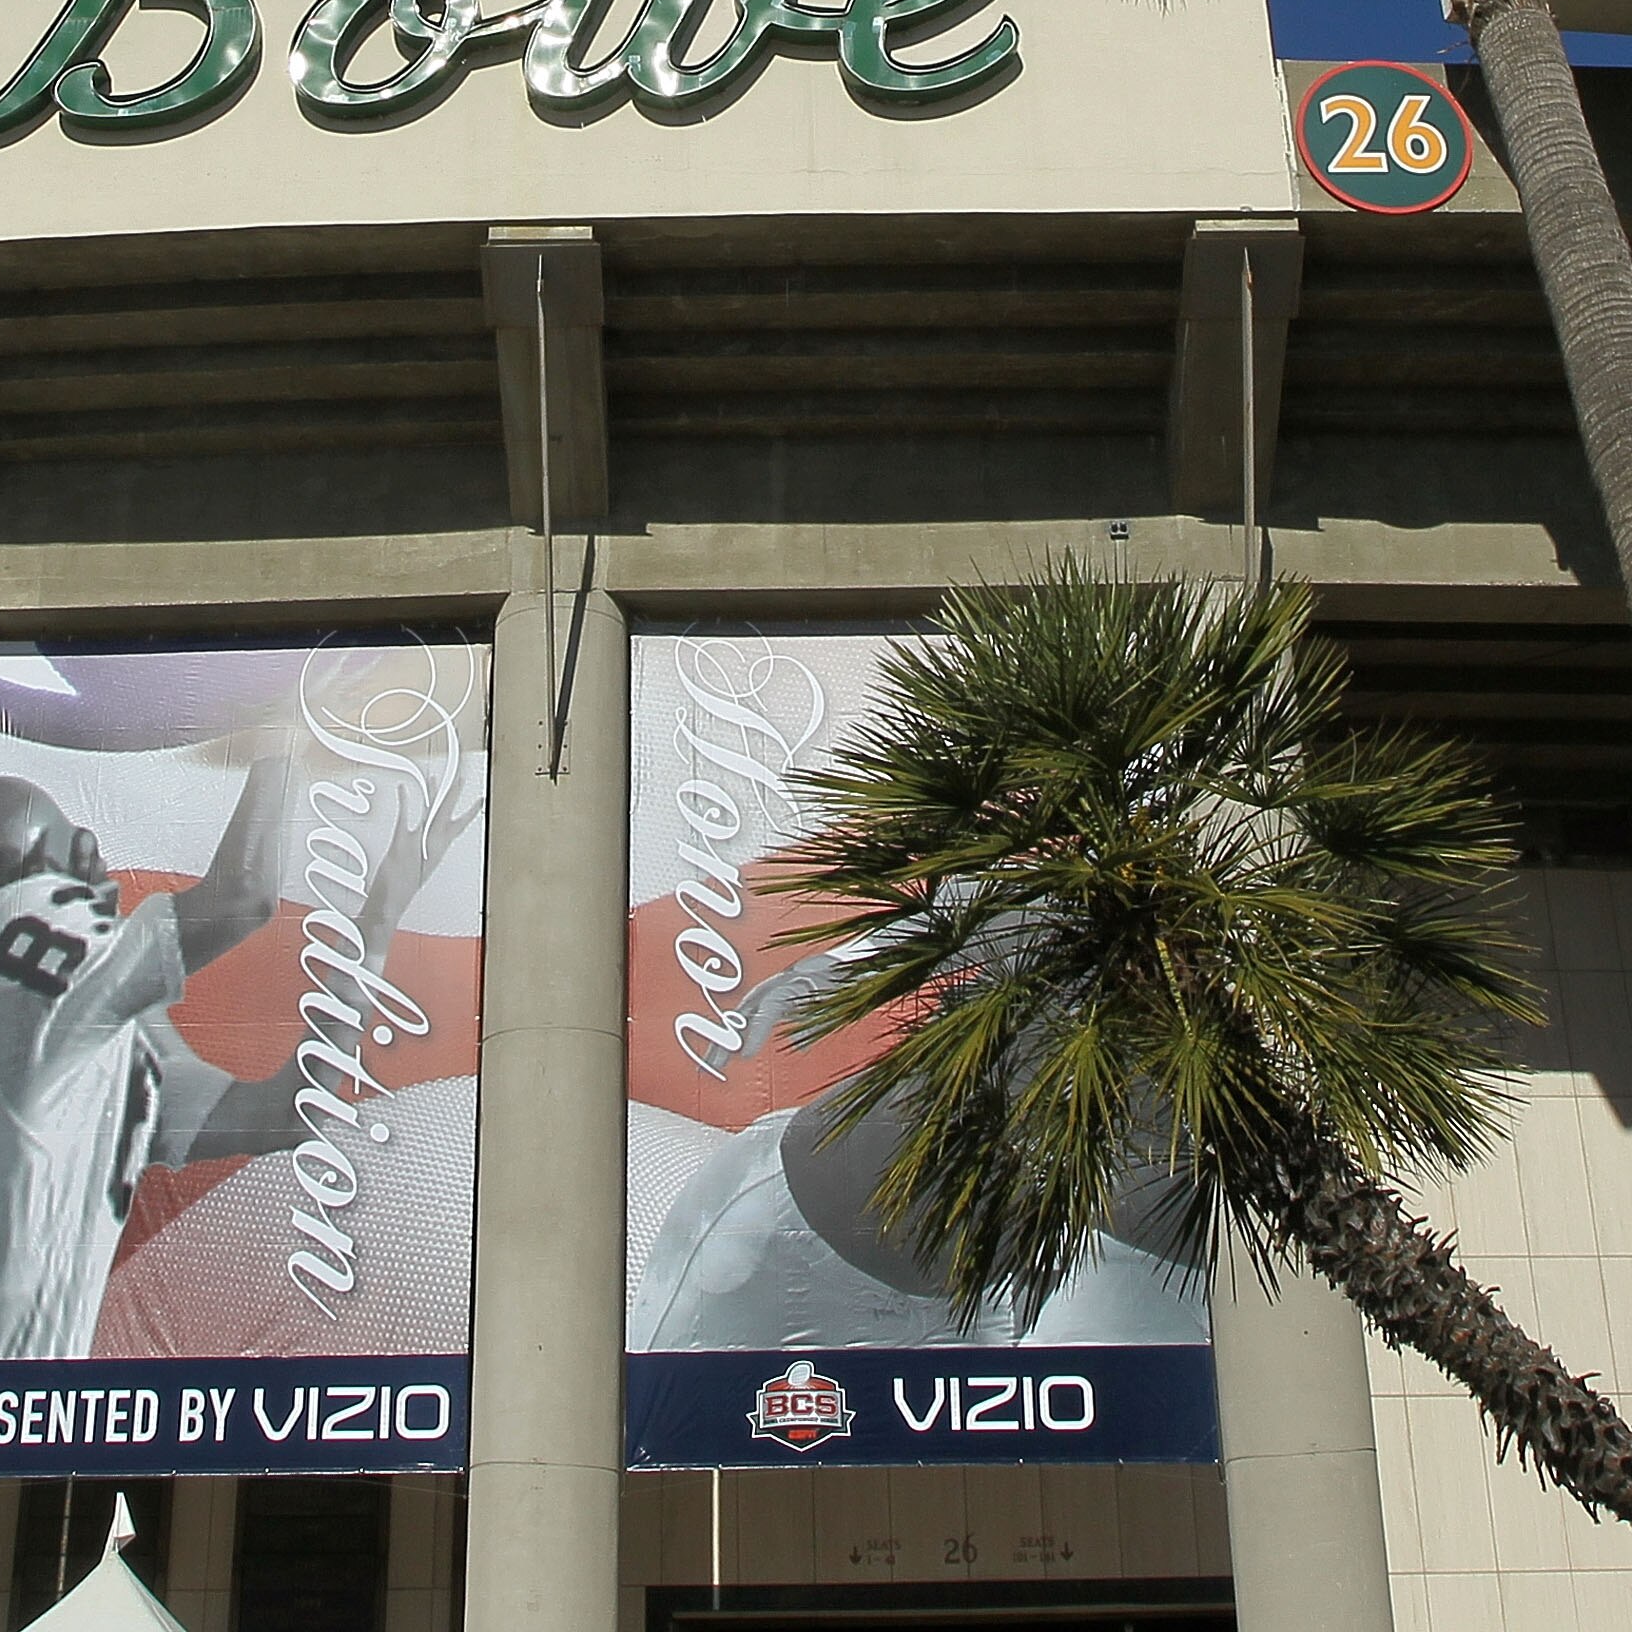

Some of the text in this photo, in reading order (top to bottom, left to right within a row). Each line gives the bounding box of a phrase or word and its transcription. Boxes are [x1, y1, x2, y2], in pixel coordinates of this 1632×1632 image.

[1319, 94, 1449, 174] 26
[673, 622, 826, 1083] Honor
[287, 626, 475, 1321] Tradition
[178, 1387, 238, 1443] BY
[254, 1384, 451, 1442] VIZIO
[764, 1393, 839, 1418] BCS
[893, 1375, 1095, 1431] VIZIO
[943, 1533, 978, 1564] 26
